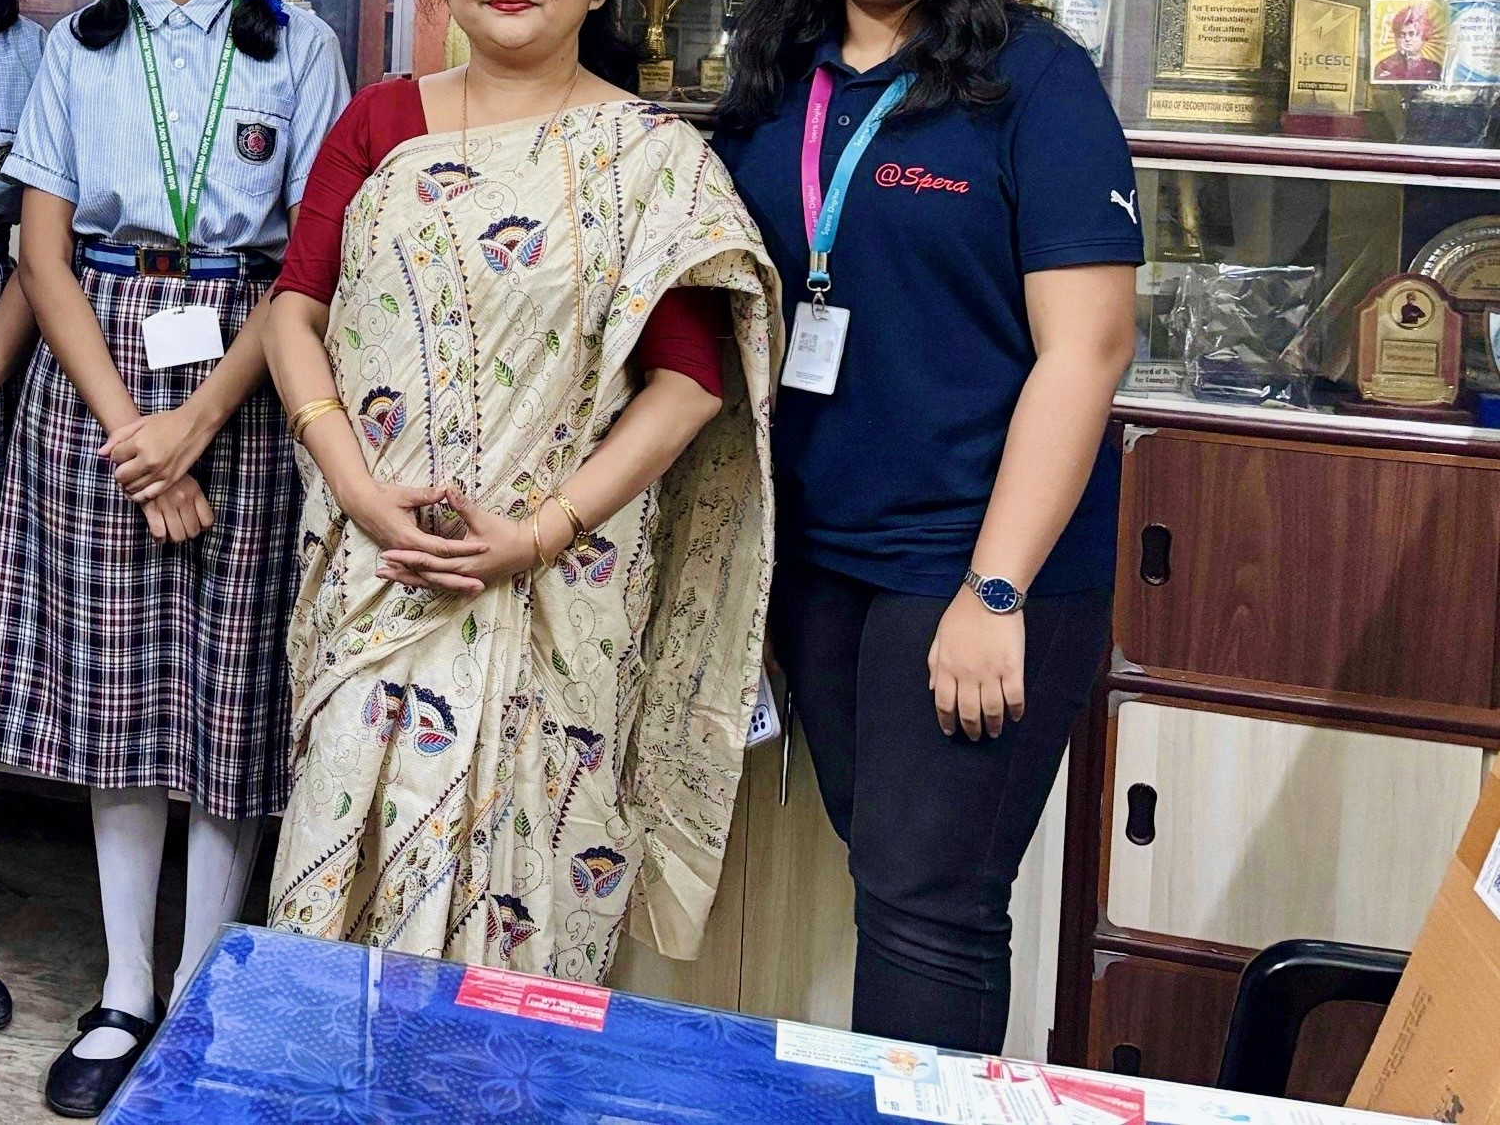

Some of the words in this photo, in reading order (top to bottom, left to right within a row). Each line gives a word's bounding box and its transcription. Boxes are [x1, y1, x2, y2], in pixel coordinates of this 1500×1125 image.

[1204, 5, 1260, 14] Environment
[1198, 34, 1250, 43] Programme
[1202, 25, 1246, 34] Education
[141, 37, 150, 49] FOR
[143, 48, 154, 72] SCHOOL
[222, 48, 231, 60] FOR
[1316, 54, 1352, 66] CESC
[148, 71, 157, 87] HIGH
[216, 59, 228, 85] SCHOOL
[213, 84, 223, 100] HIGH
[151, 87, 164, 123] SPONSORED
[813, 102, 822, 122] Digital
[1151, 99, 1173, 109] AWARD
[1182, 100, 1222, 112] RECOGNITION
[1222, 102, 1234, 112] FOR
[205, 100, 219, 135] SPONSORED
[156, 121, 167, 141] GOVT.
[809, 123, 819, 144] Spera
[853, 127, 870, 147] Spera
[160, 140, 170, 159] ROAD
[200, 135, 210, 155] GOVT.
[164, 158, 173, 174] DUM
[195, 153, 206, 173] ROAD
[167, 174, 176, 190] DUM
[192, 172, 201, 188] DUM
[875, 163, 970, 194] @Spera
[189, 188, 199, 204] DUM
[827, 188, 841, 213] Digital
[821, 213, 834, 236] Spera
